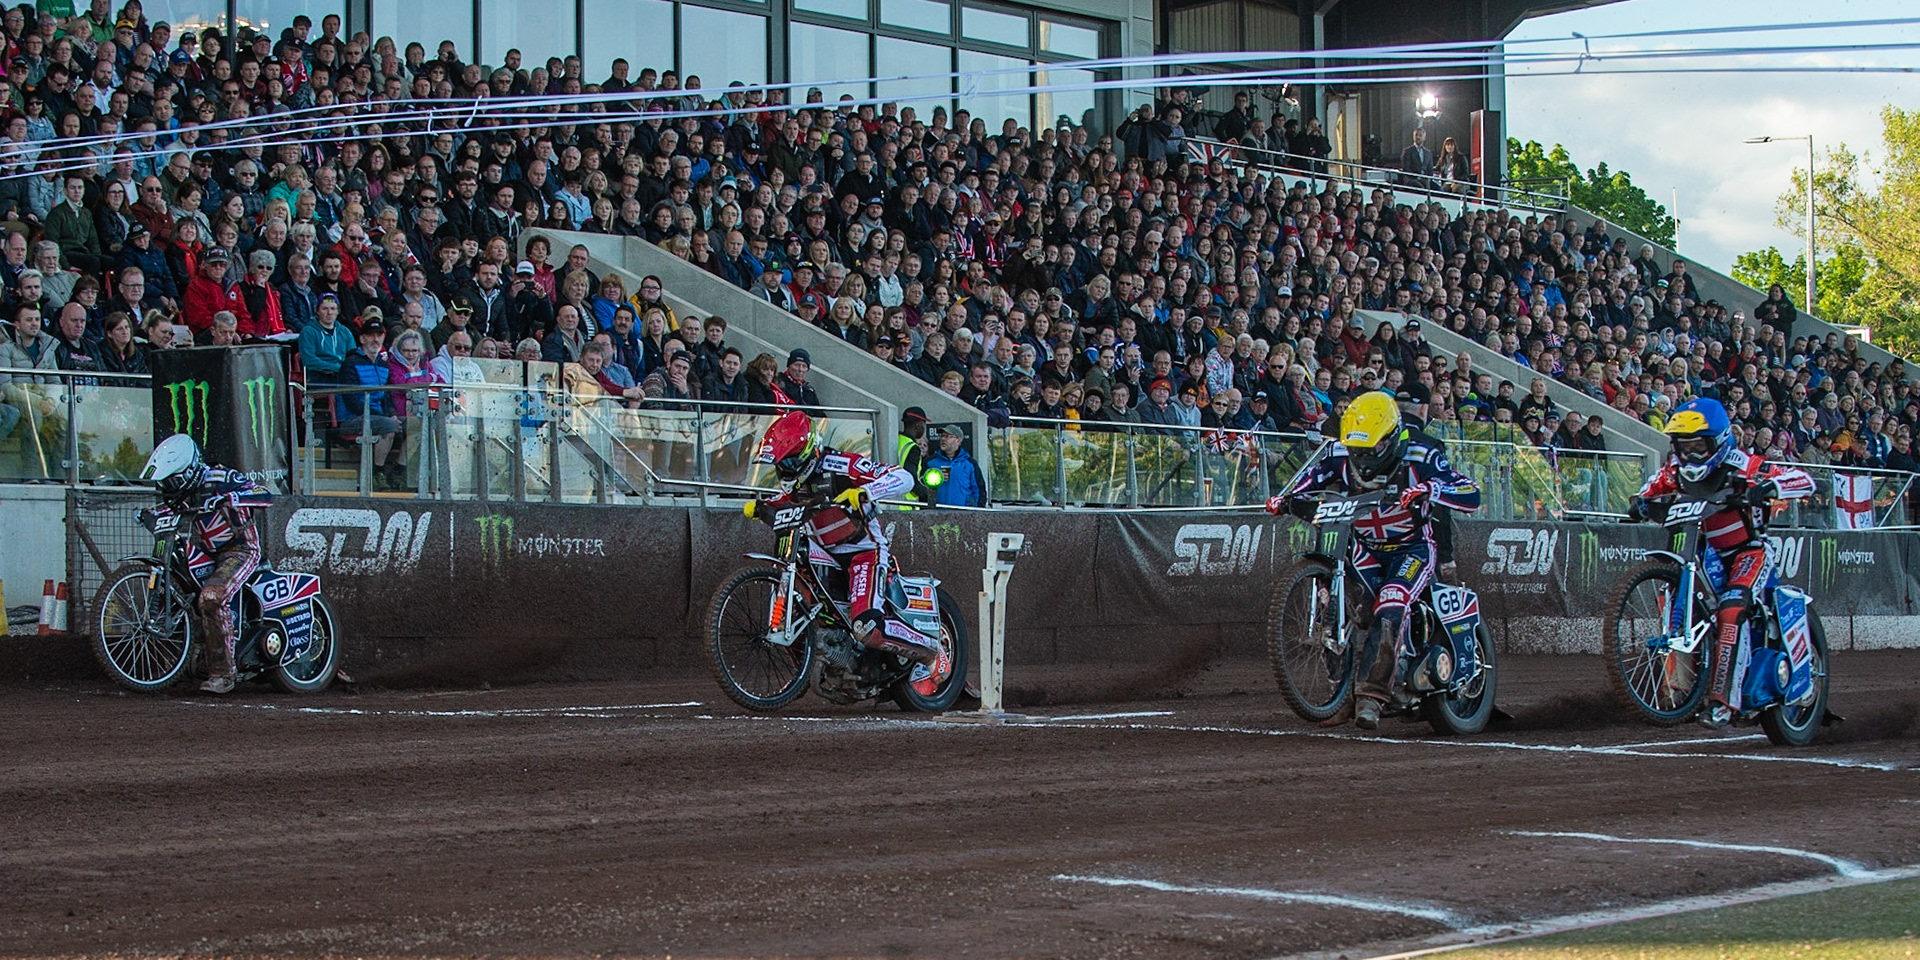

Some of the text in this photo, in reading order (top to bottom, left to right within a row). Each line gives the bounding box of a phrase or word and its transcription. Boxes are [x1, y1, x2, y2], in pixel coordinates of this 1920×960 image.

[1665, 501, 1707, 522] SDN
[277, 508, 433, 576] SDN
[1166, 524, 1264, 577] SDN
[1481, 528, 1559, 576] SDN
[1837, 548, 1876, 566] MONSTER
[262, 579, 290, 602] GB
[1379, 589, 1405, 603] STAR
[1438, 590, 1461, 615] GB
